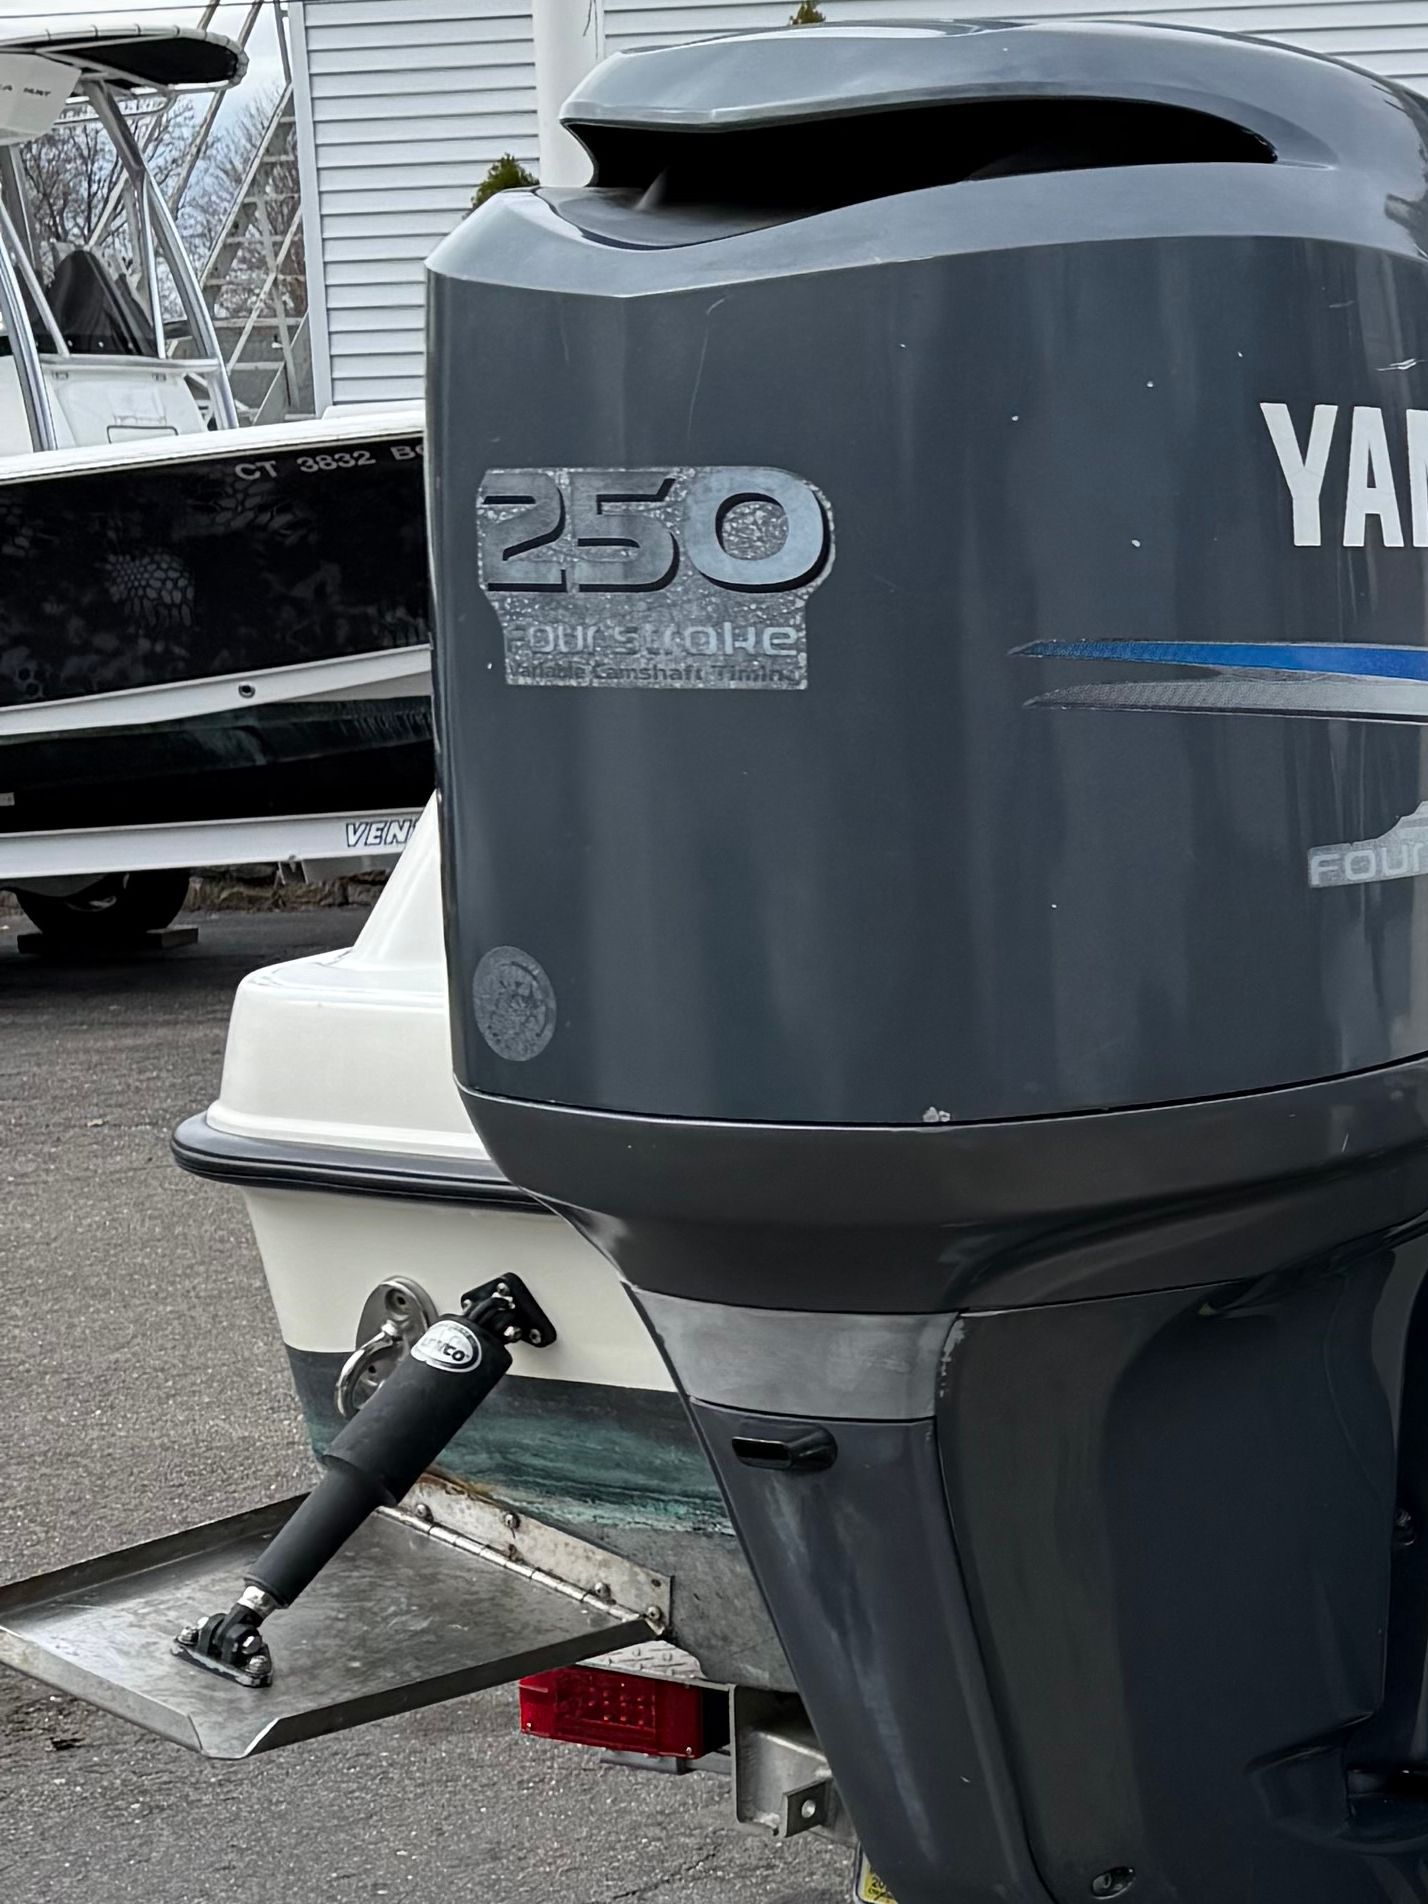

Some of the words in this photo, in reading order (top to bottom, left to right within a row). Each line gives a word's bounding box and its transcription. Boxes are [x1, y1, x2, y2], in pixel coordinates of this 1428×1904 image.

[235, 460, 278, 480] CT
[296, 450, 376, 473] 3832
[478, 466, 832, 594] 250
[597, 664, 704, 682] Camshaft
[345, 818, 420, 848] VEN
